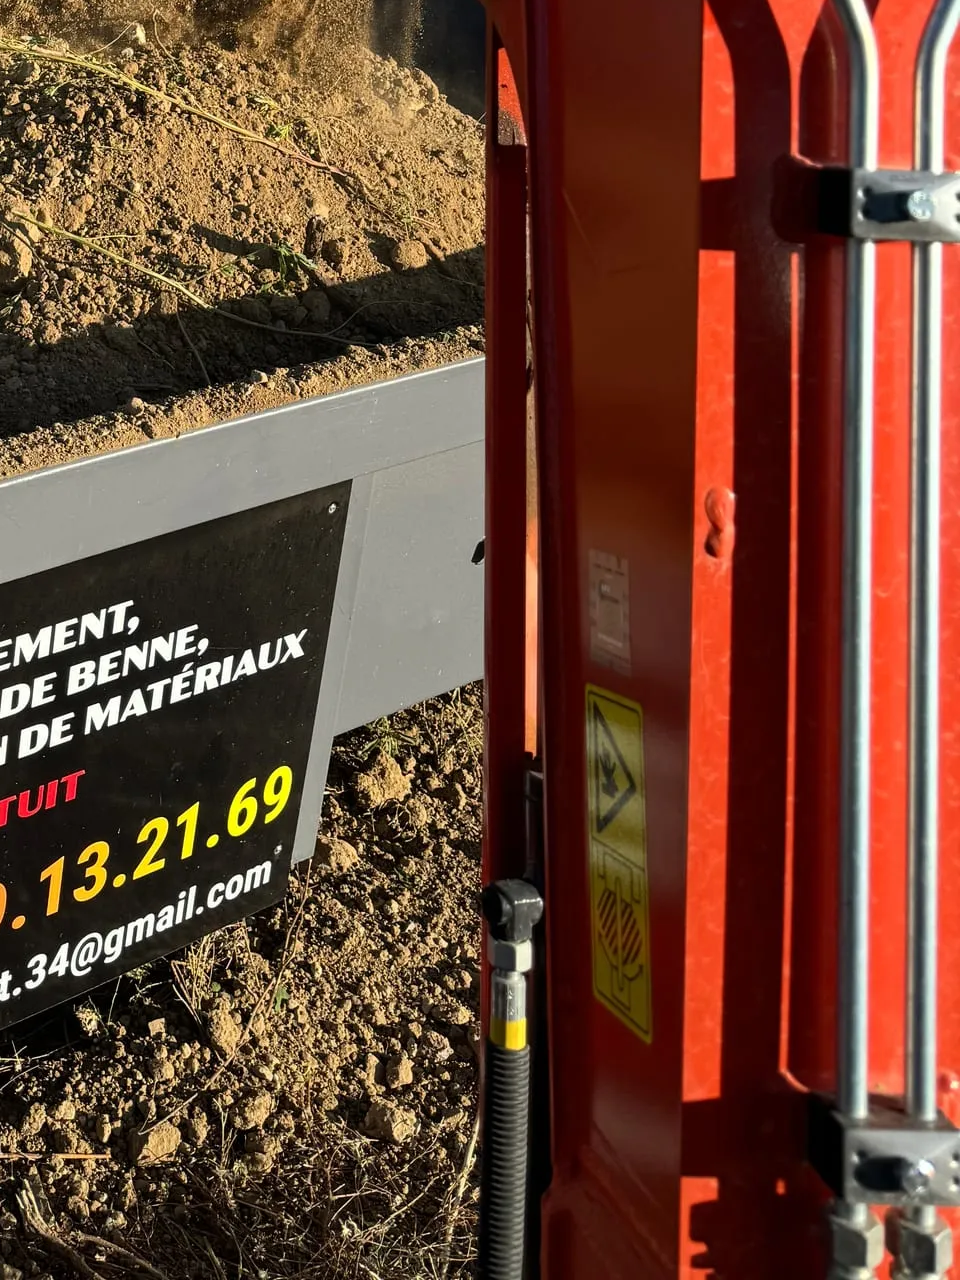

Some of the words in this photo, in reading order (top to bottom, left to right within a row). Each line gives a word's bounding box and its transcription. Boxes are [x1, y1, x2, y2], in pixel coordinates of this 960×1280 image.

[0, 672, 58, 719] DE
[66, 624, 210, 696] BENNE,
[17, 712, 76, 759] DE
[84, 628, 308, 735] MATÉRIAUX
